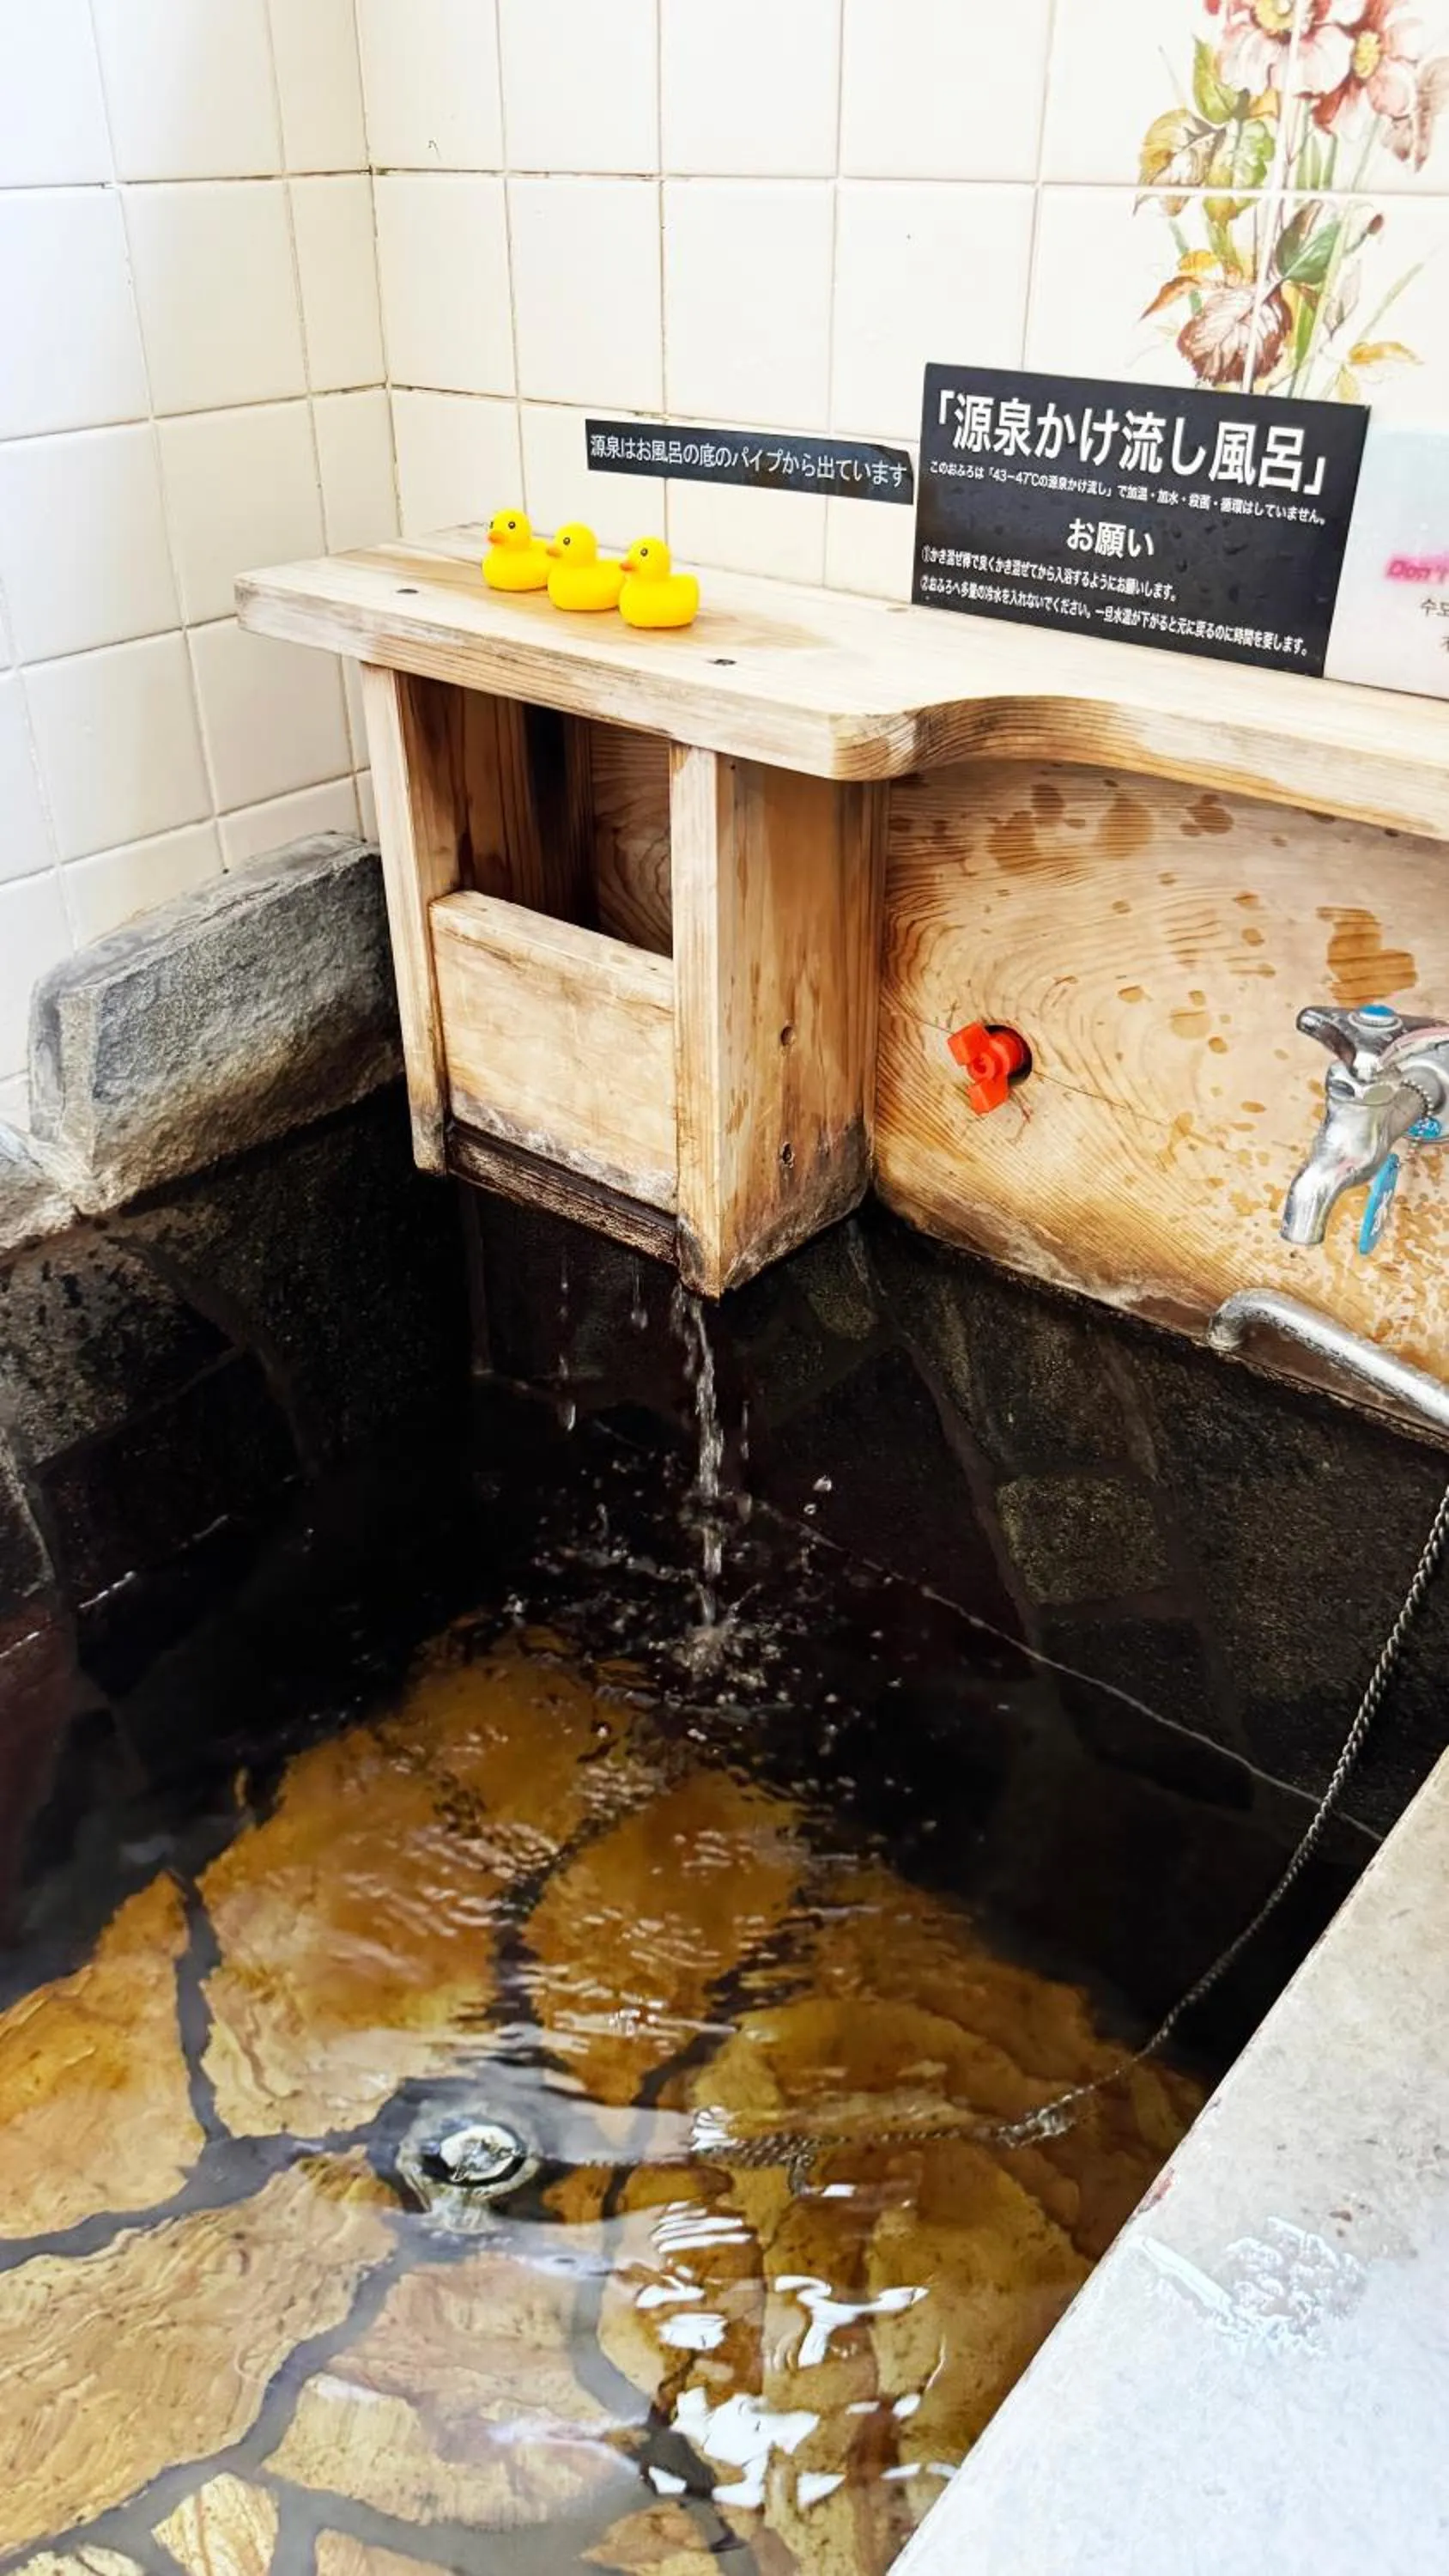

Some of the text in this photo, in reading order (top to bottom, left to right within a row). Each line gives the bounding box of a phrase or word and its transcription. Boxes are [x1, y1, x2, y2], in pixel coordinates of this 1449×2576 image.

[590, 434, 907, 488] 源泉はお風呂の底のパイプから出ています
[937, 389, 1327, 496] 「源泉かけ流し風呂」
[1066, 518, 1155, 559] お願い
